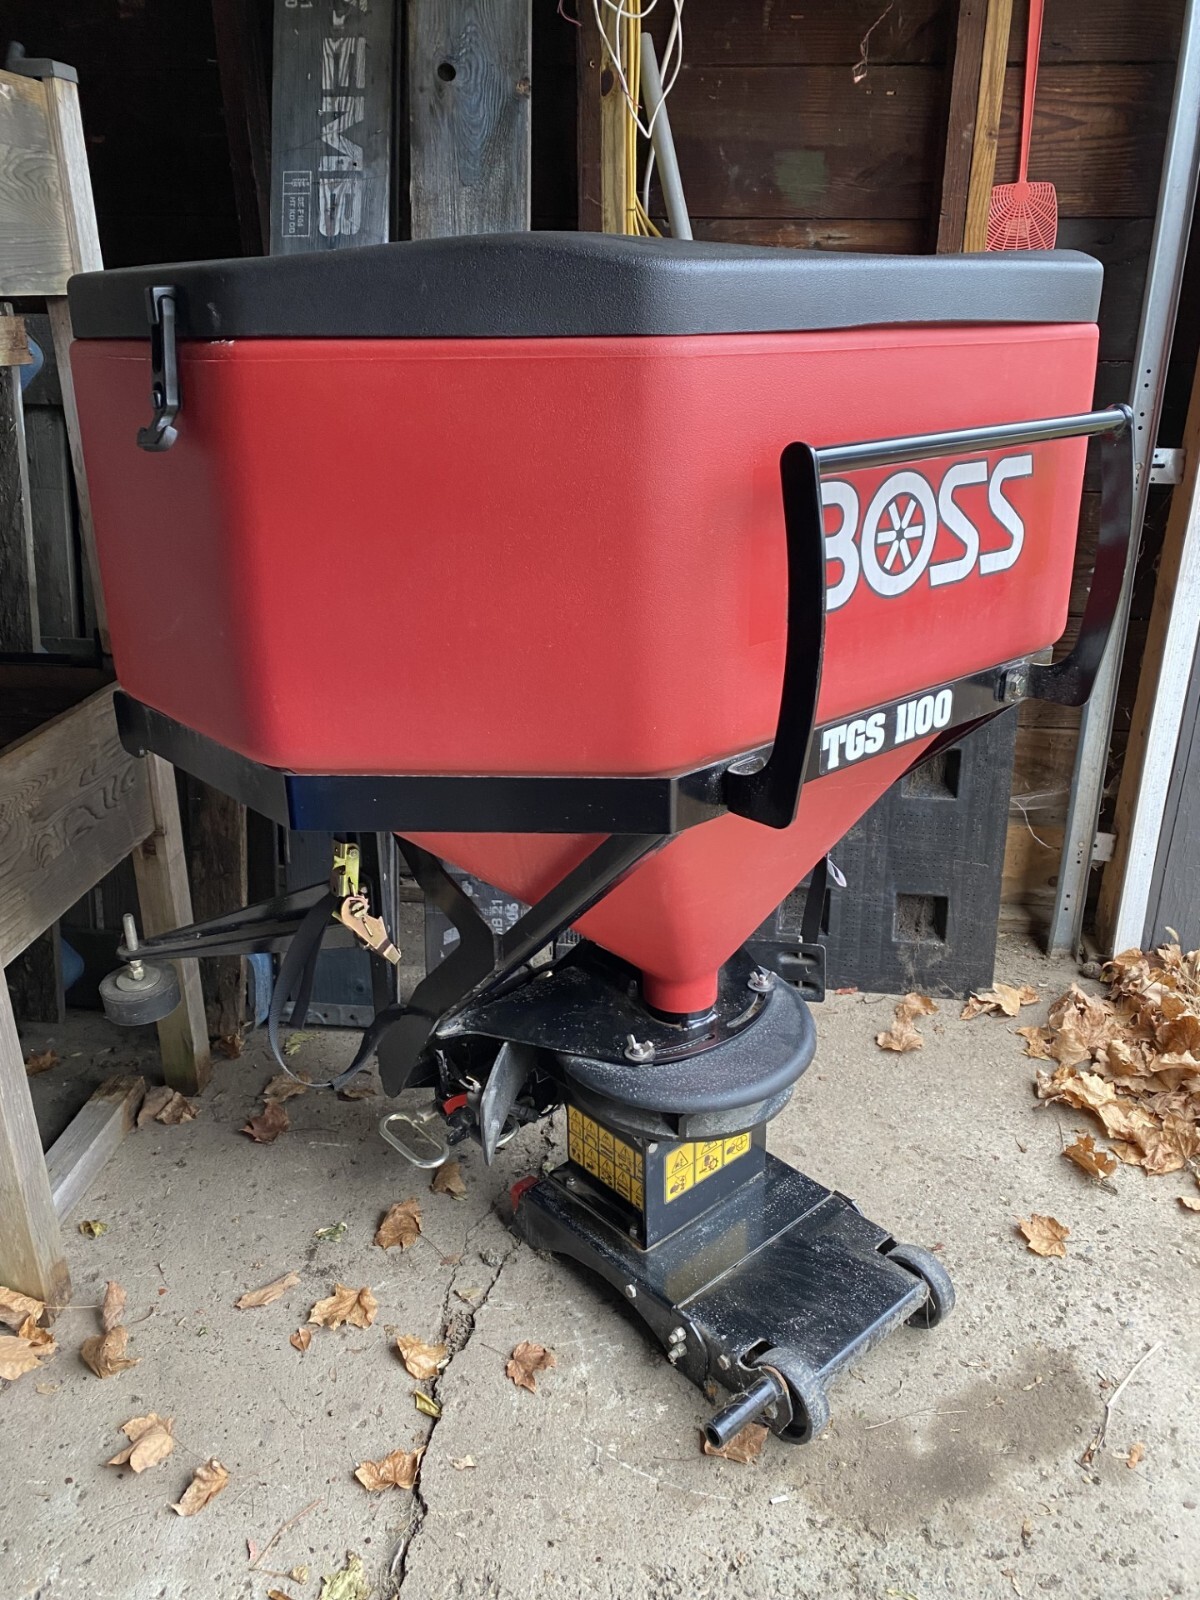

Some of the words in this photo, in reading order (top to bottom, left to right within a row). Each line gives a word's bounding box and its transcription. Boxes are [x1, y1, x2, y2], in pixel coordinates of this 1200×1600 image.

[818, 452, 1034, 613] BOSS
[822, 712, 886, 770] TGS
[894, 688, 953, 744] 1100
